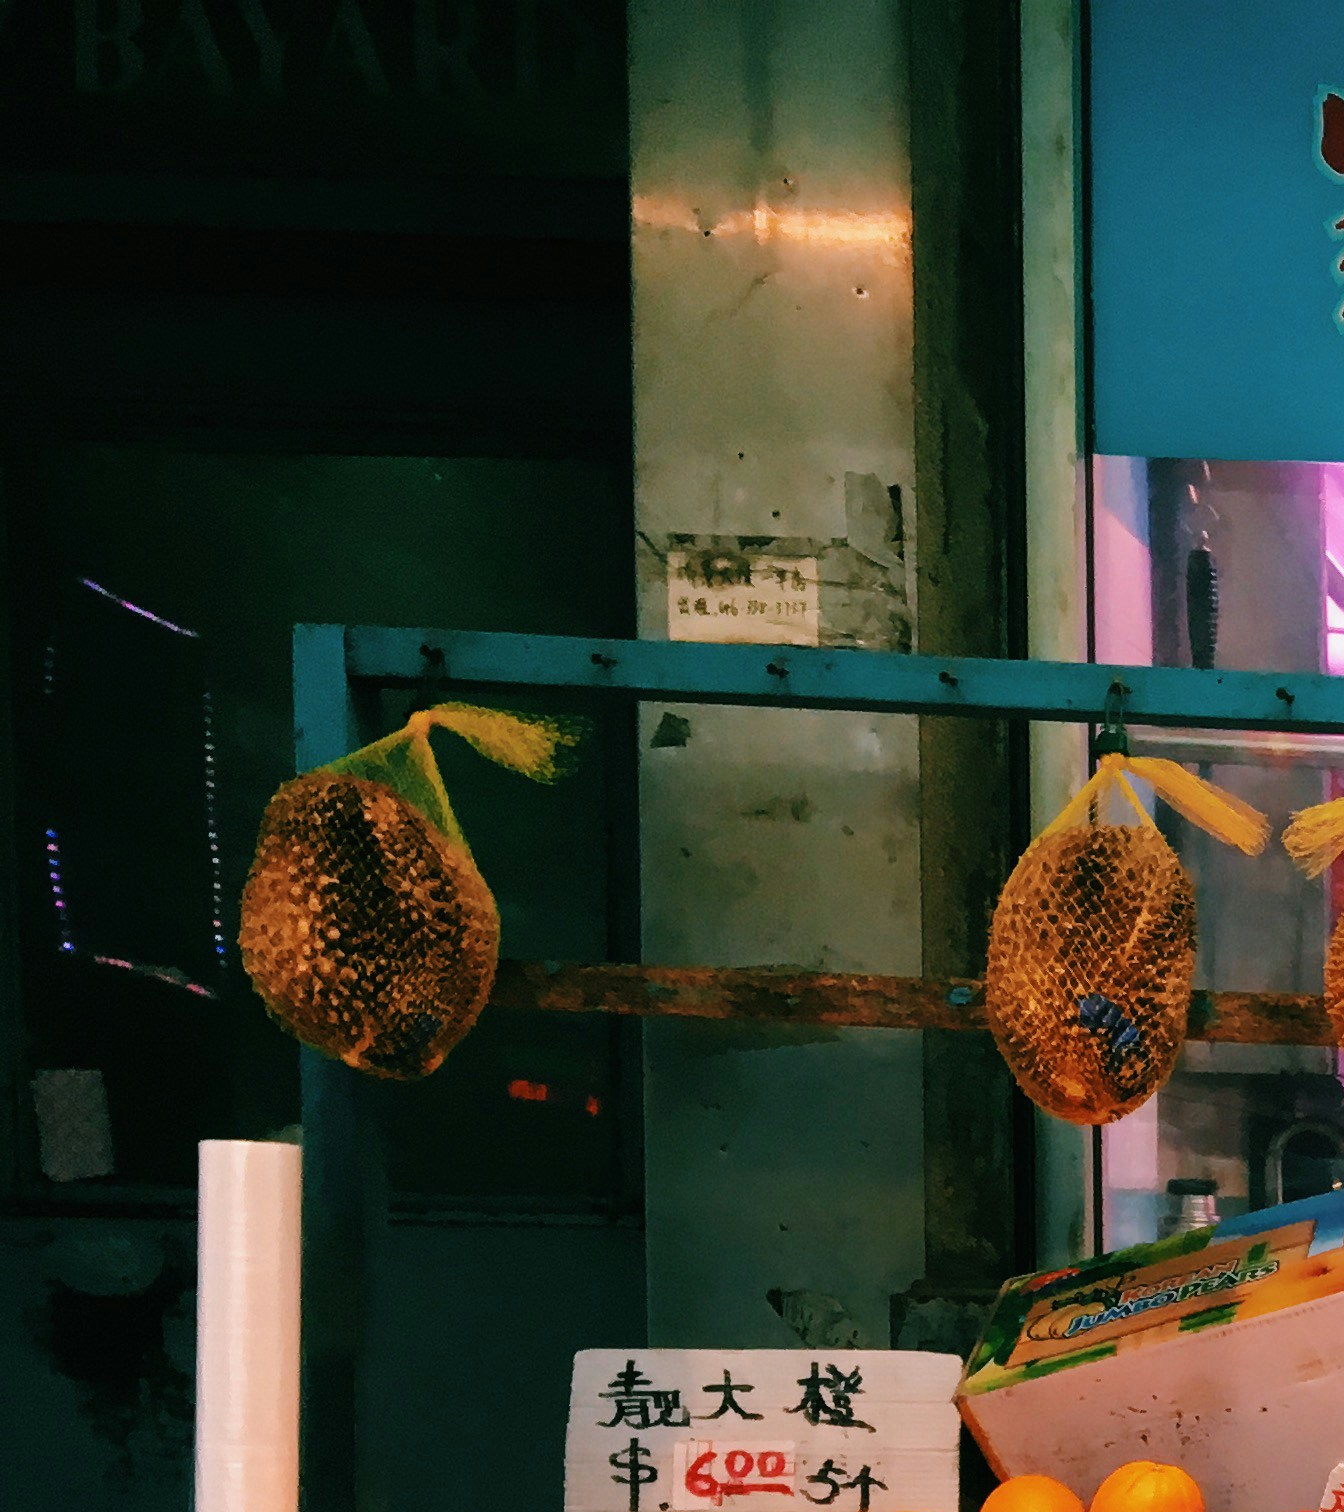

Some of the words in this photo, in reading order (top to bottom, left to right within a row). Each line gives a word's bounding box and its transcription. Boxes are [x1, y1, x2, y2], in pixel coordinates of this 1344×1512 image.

[1064, 1291, 1180, 1337] JUMBO
[1177, 1261, 1279, 1301] PEARS
[1119, 1260, 1239, 1304] KOREAN
